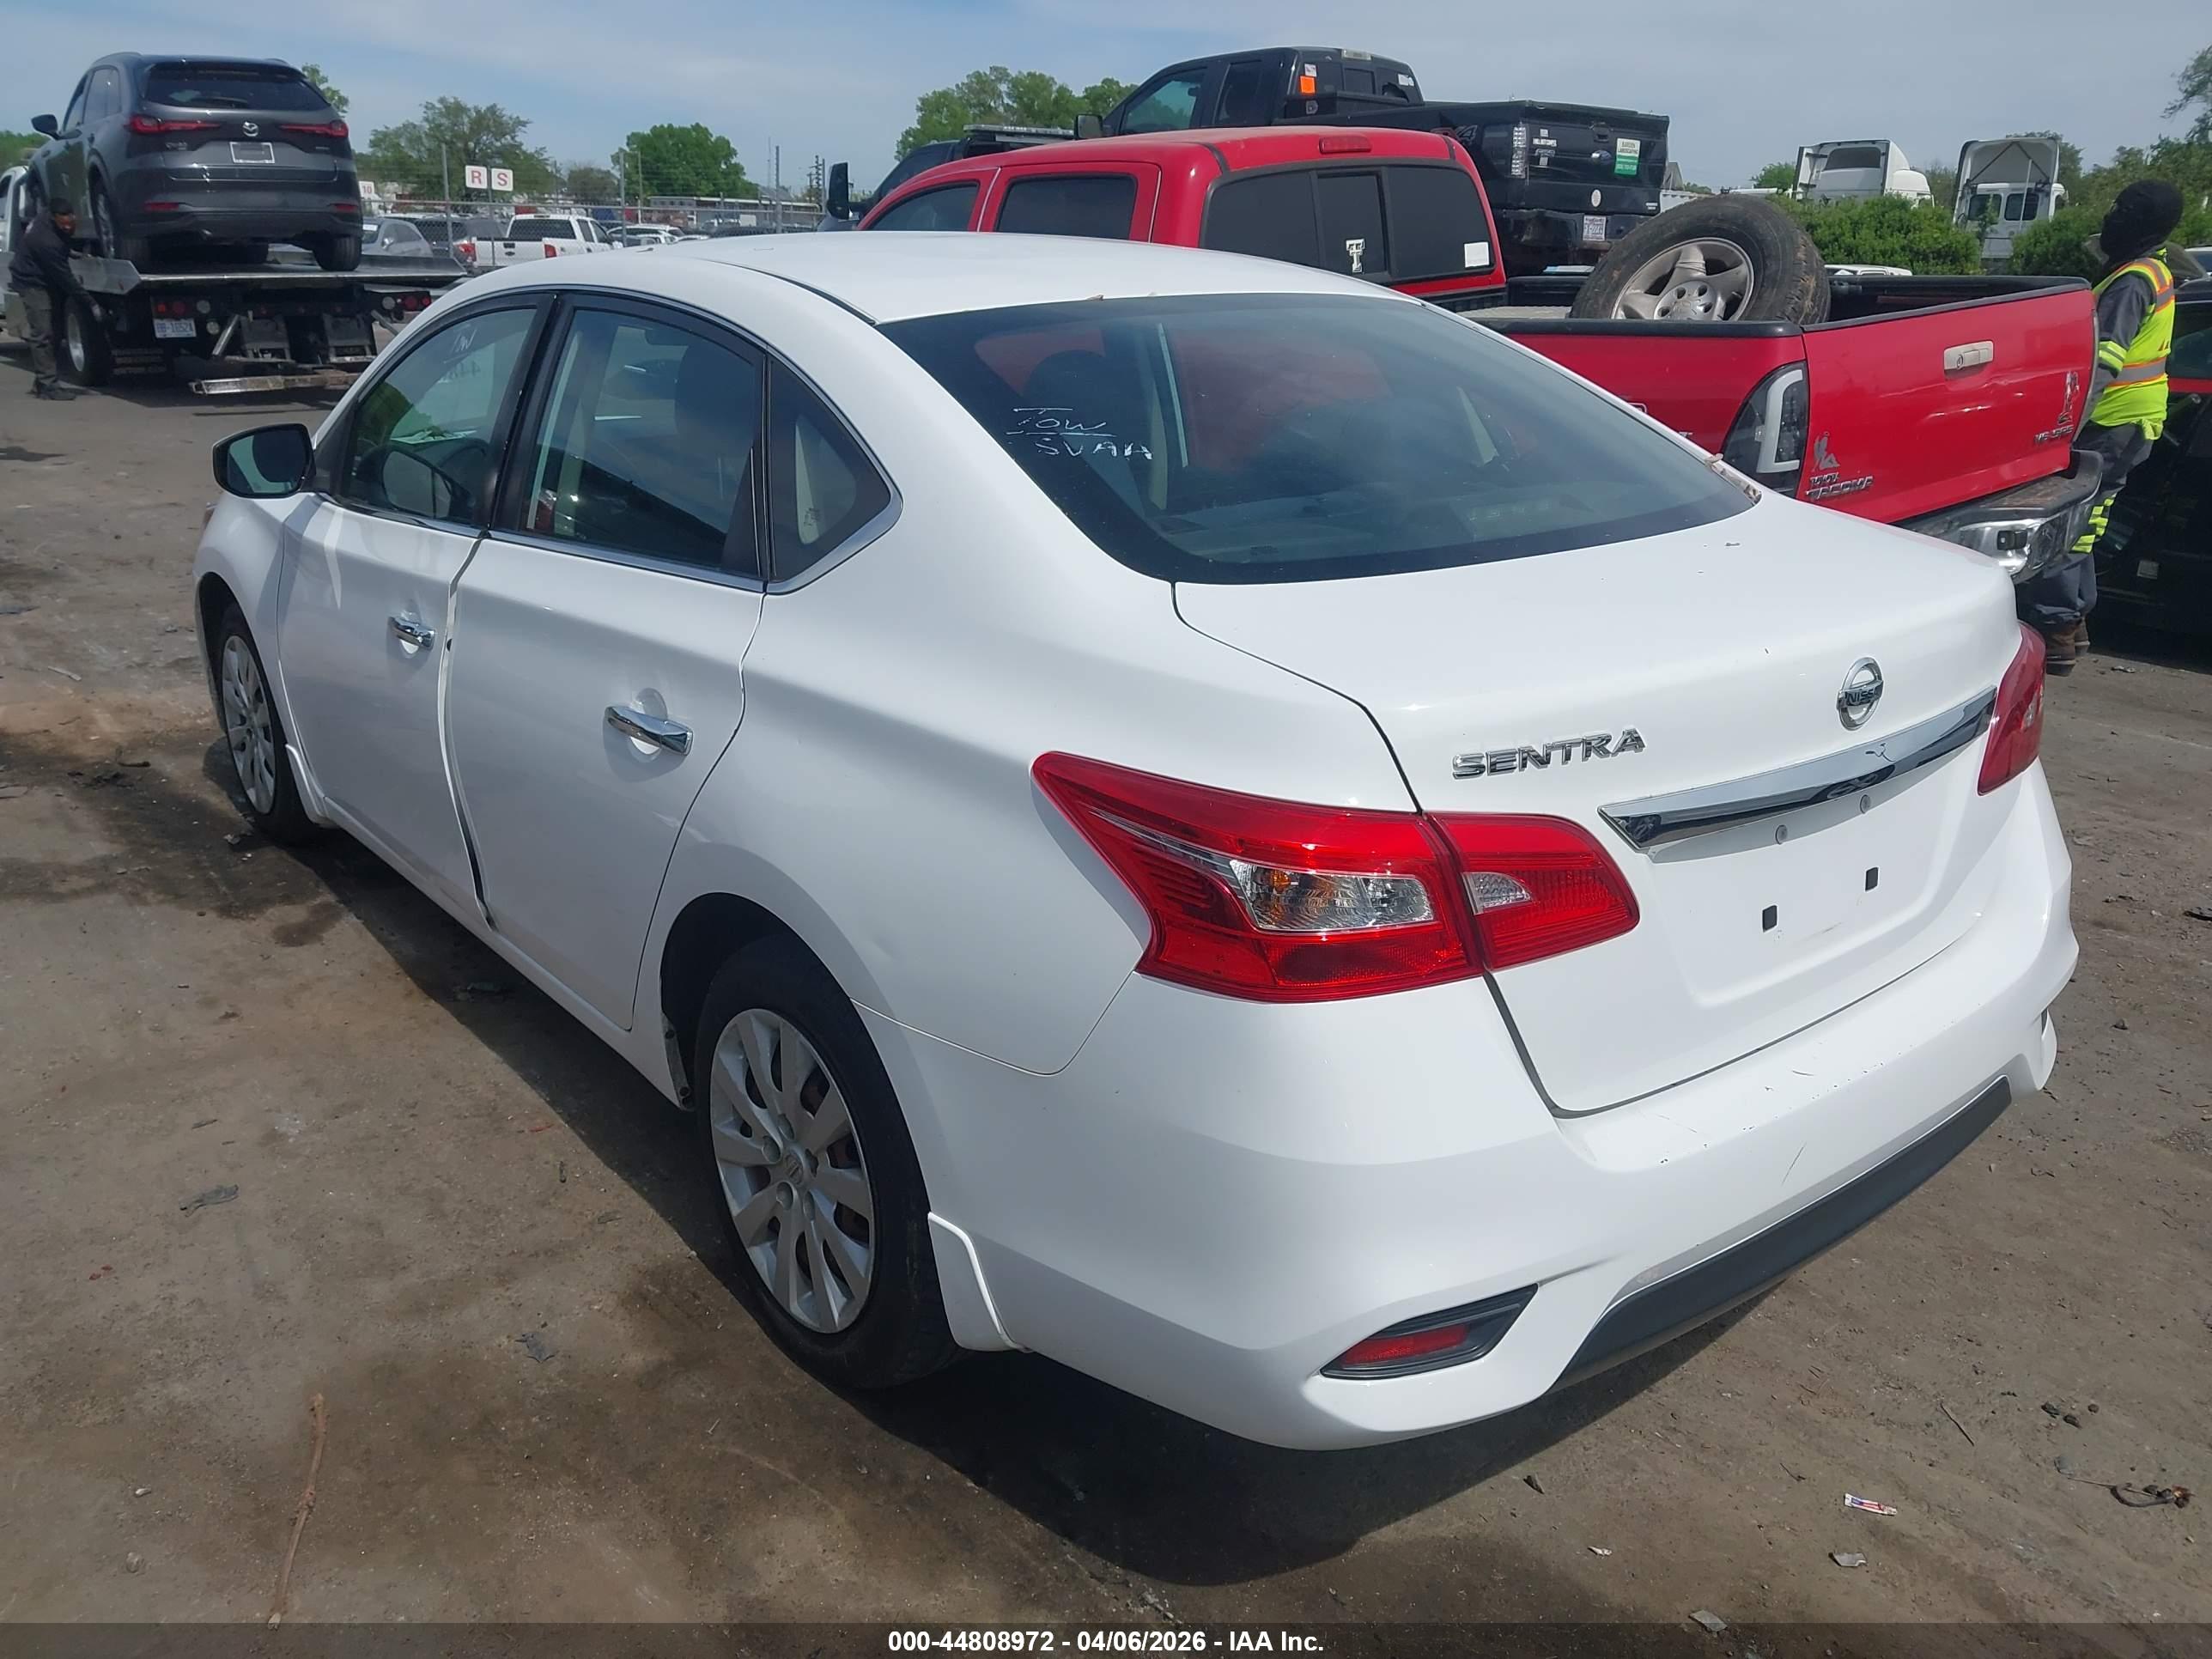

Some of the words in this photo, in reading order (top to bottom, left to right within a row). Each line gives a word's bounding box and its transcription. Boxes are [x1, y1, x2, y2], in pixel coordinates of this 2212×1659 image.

[471, 171, 482, 184] R
[497, 173, 508, 186] S
[362, 185, 372, 194] 10
[1805, 475, 1874, 500] TACOMA
[1845, 688, 1881, 703] NISS
[1452, 727, 1646, 781] SENTRA
